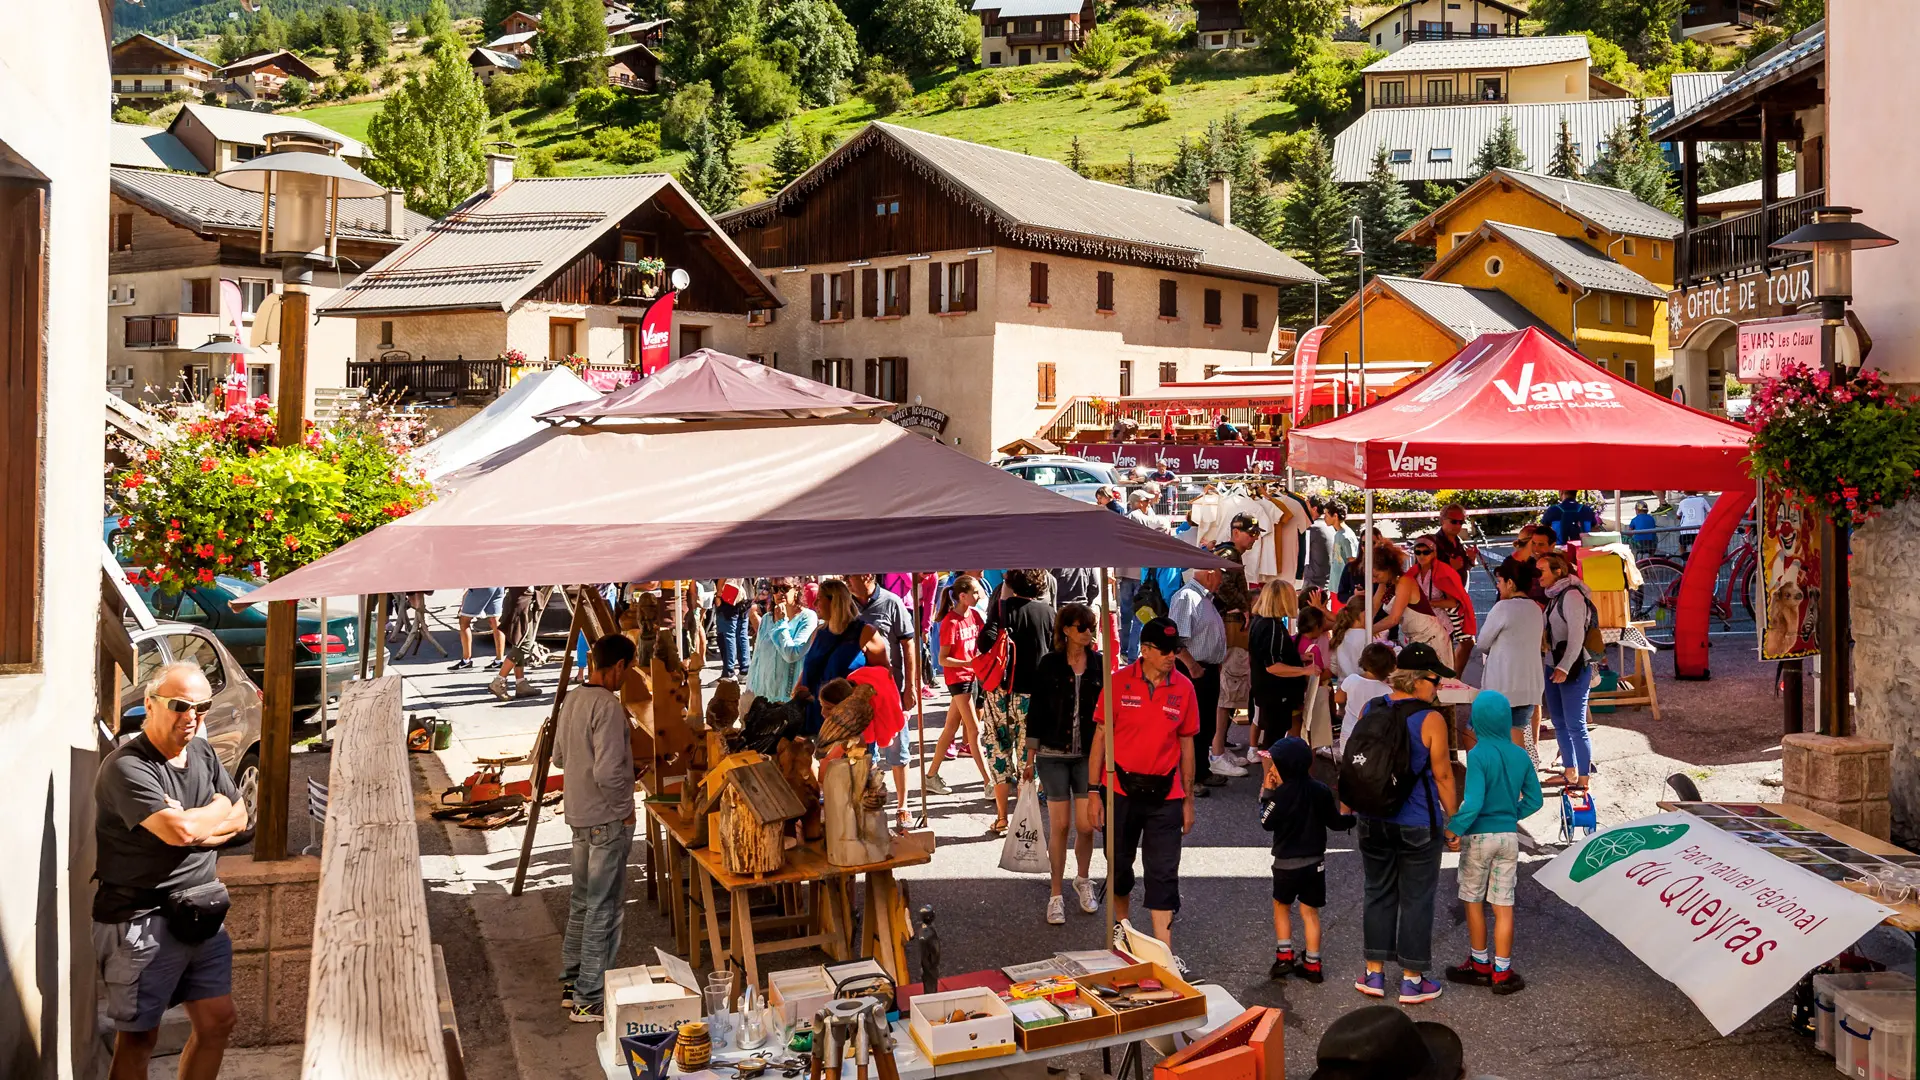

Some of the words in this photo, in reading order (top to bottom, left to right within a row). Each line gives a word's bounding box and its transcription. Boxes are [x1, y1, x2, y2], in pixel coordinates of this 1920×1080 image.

[1687, 285, 1731, 319] OFFICE
[1739, 281, 1756, 311] DE
[1765, 269, 1812, 306] TOUR
[642, 322, 669, 346] Vars
[1750, 331, 1775, 350] VARS
[1778, 333, 1790, 347] Les
[1792, 331, 1814, 346] Claux
[1741, 355, 1756, 371] Col
[1760, 353, 1771, 370] de
[1492, 362, 1616, 405] Vars
[1568, 400, 1625, 408] BLANCHE
[1112, 446, 1135, 468] Vars
[1192, 447, 1220, 470] Vars
[1387, 441, 1438, 472] Vars
[1674, 845, 1712, 865] Parc
[1703, 861, 1767, 891] naturel
[1750, 886, 1829, 935] régional
[1625, 861, 1673, 887] du
[1659, 875, 1778, 966] Queyras
